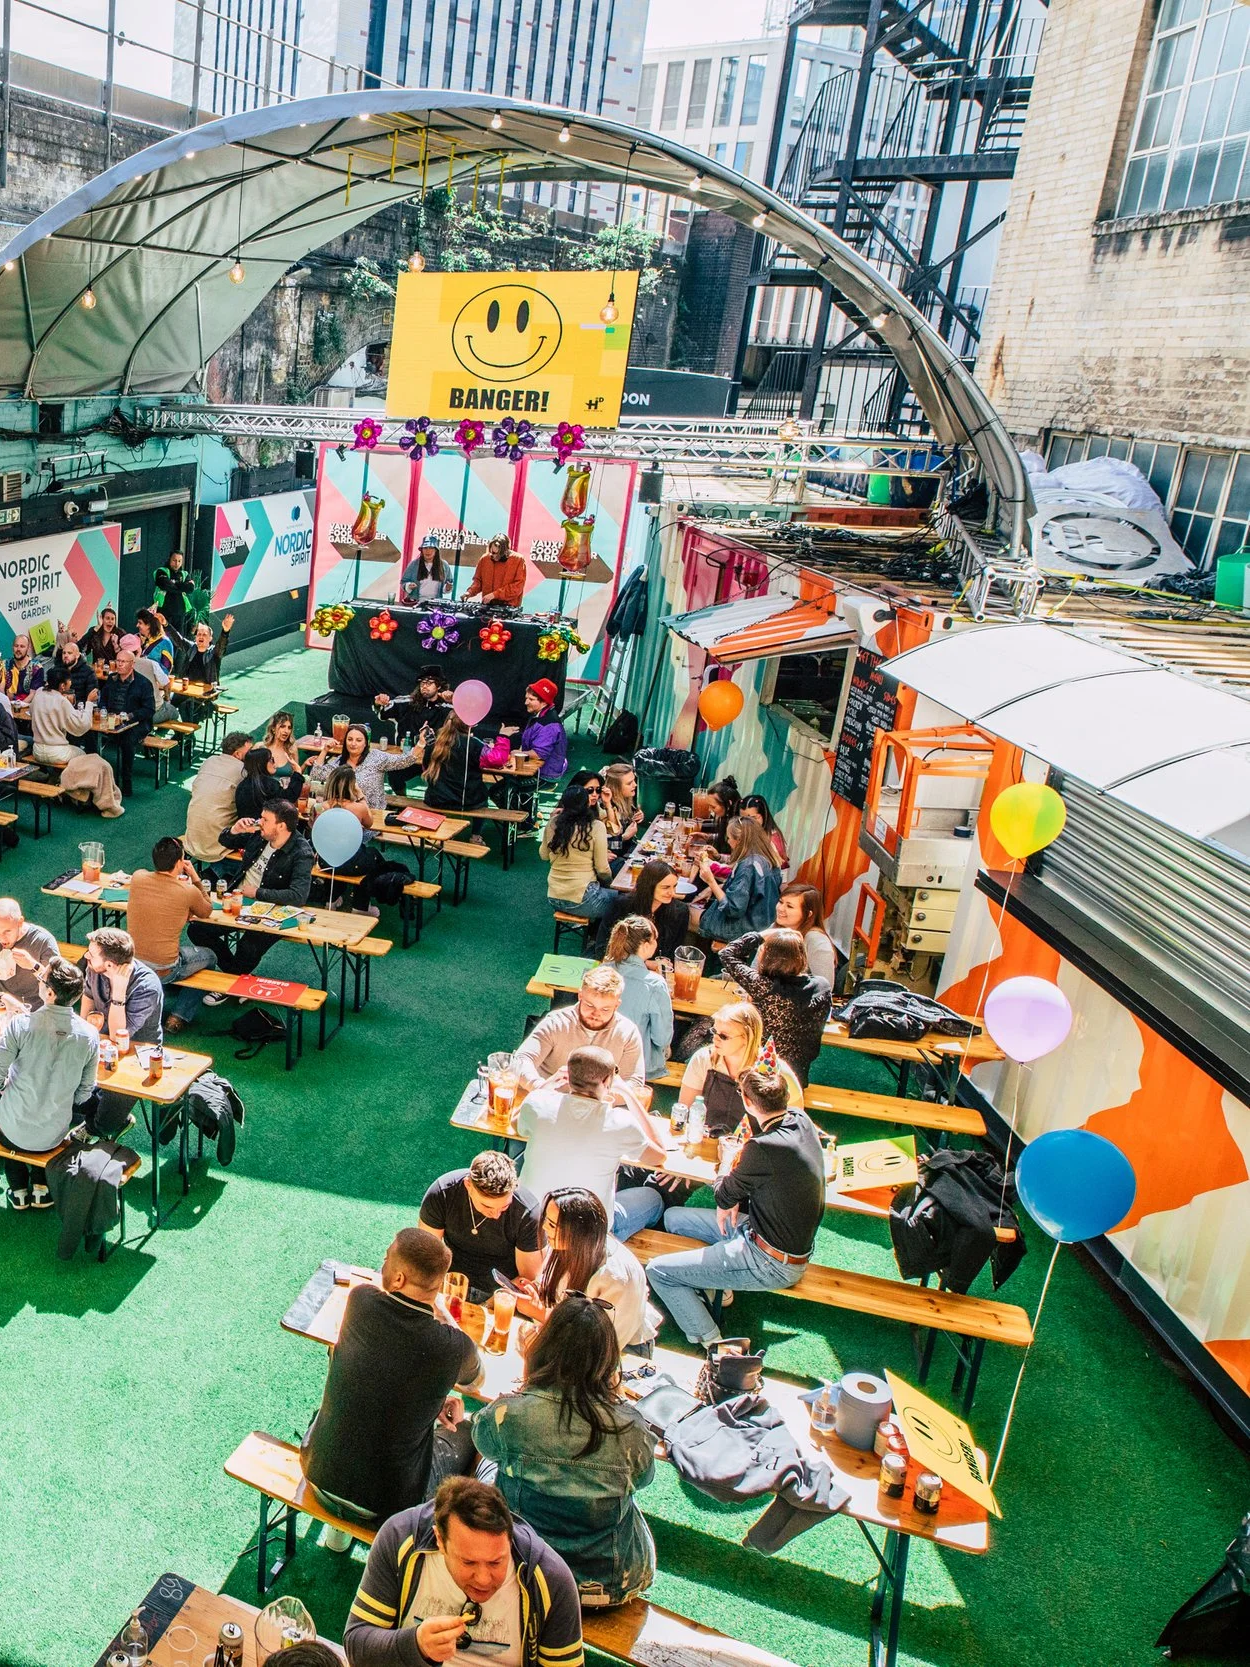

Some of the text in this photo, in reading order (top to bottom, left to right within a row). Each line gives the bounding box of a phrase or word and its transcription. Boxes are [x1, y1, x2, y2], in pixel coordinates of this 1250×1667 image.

[449, 387, 549, 412] BANGER!
[329, 523, 353, 531] VAUX
[428, 527, 477, 538] VAUXHALL
[274, 529, 312, 557] NORDIC
[329, 536, 358, 545] GARD
[439, 541, 465, 551] RDEN
[463, 536, 489, 546] BEER
[531, 539, 564, 549] VAUXH
[291, 550, 310, 567] SPIRIT
[529, 553, 559, 564] GARD
[530, 547, 559, 556] FOOD
[21, 571, 62, 595] SPIRIT
[8, 596, 39, 612] SUMMER
[21, 604, 51, 620] GARDEN
[843, 1156, 855, 1178] BANGER!
[958, 1438, 984, 1484] BANGER!
[159, 1578, 183, 1600] 58
